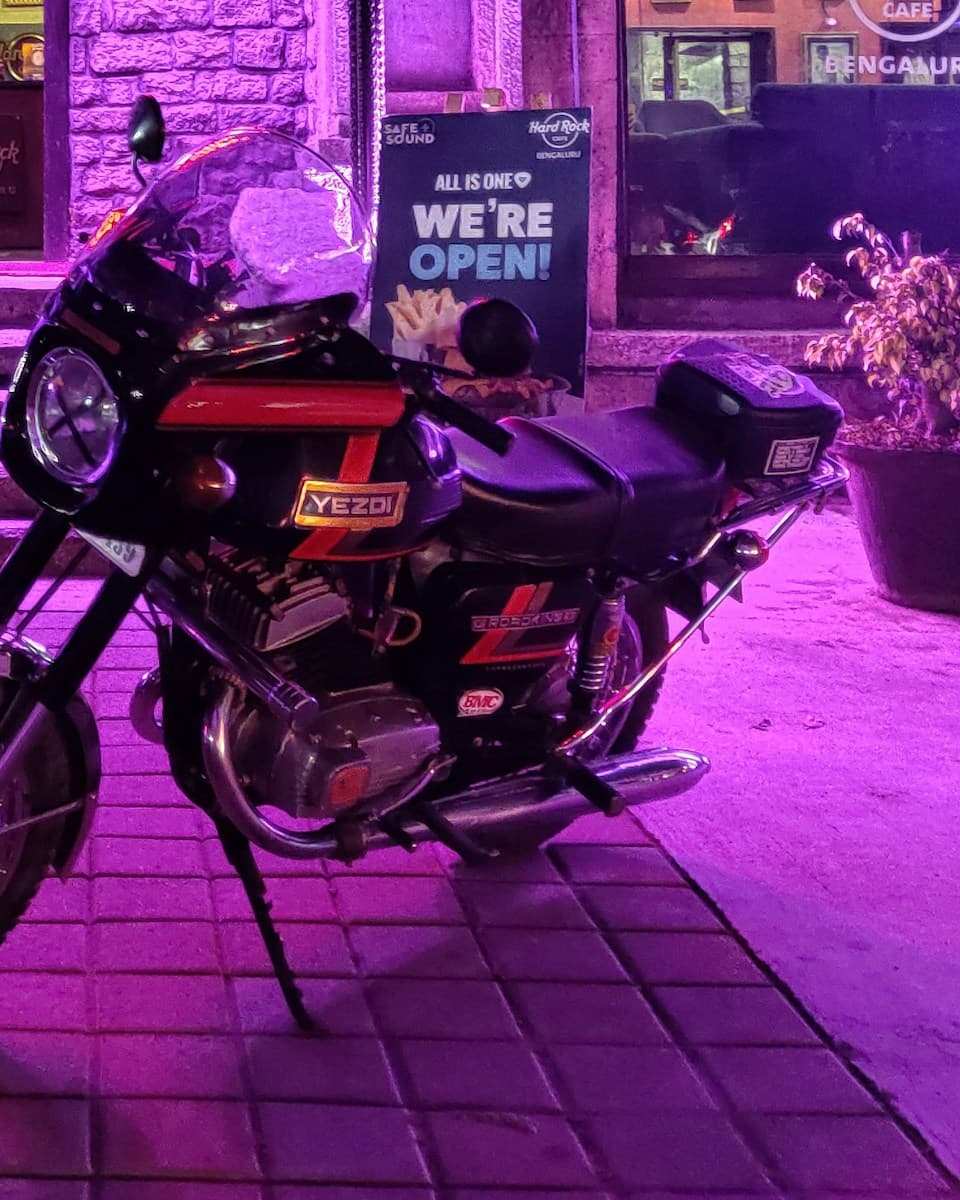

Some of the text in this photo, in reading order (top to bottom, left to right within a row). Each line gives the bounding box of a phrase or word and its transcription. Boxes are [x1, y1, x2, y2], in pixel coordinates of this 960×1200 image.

[882, 2, 933, 18] CAFE
[384, 123, 418, 135] SAFE
[529, 119, 590, 135] Hard Rock
[385, 133, 435, 145] SOUND
[434, 173, 514, 191] ALL IS ONE
[412, 198, 553, 239] WE'RE
[409, 243, 552, 280] OPEN!
[310, 494, 393, 515] YEZDI
[463, 695, 499, 708] BMC
